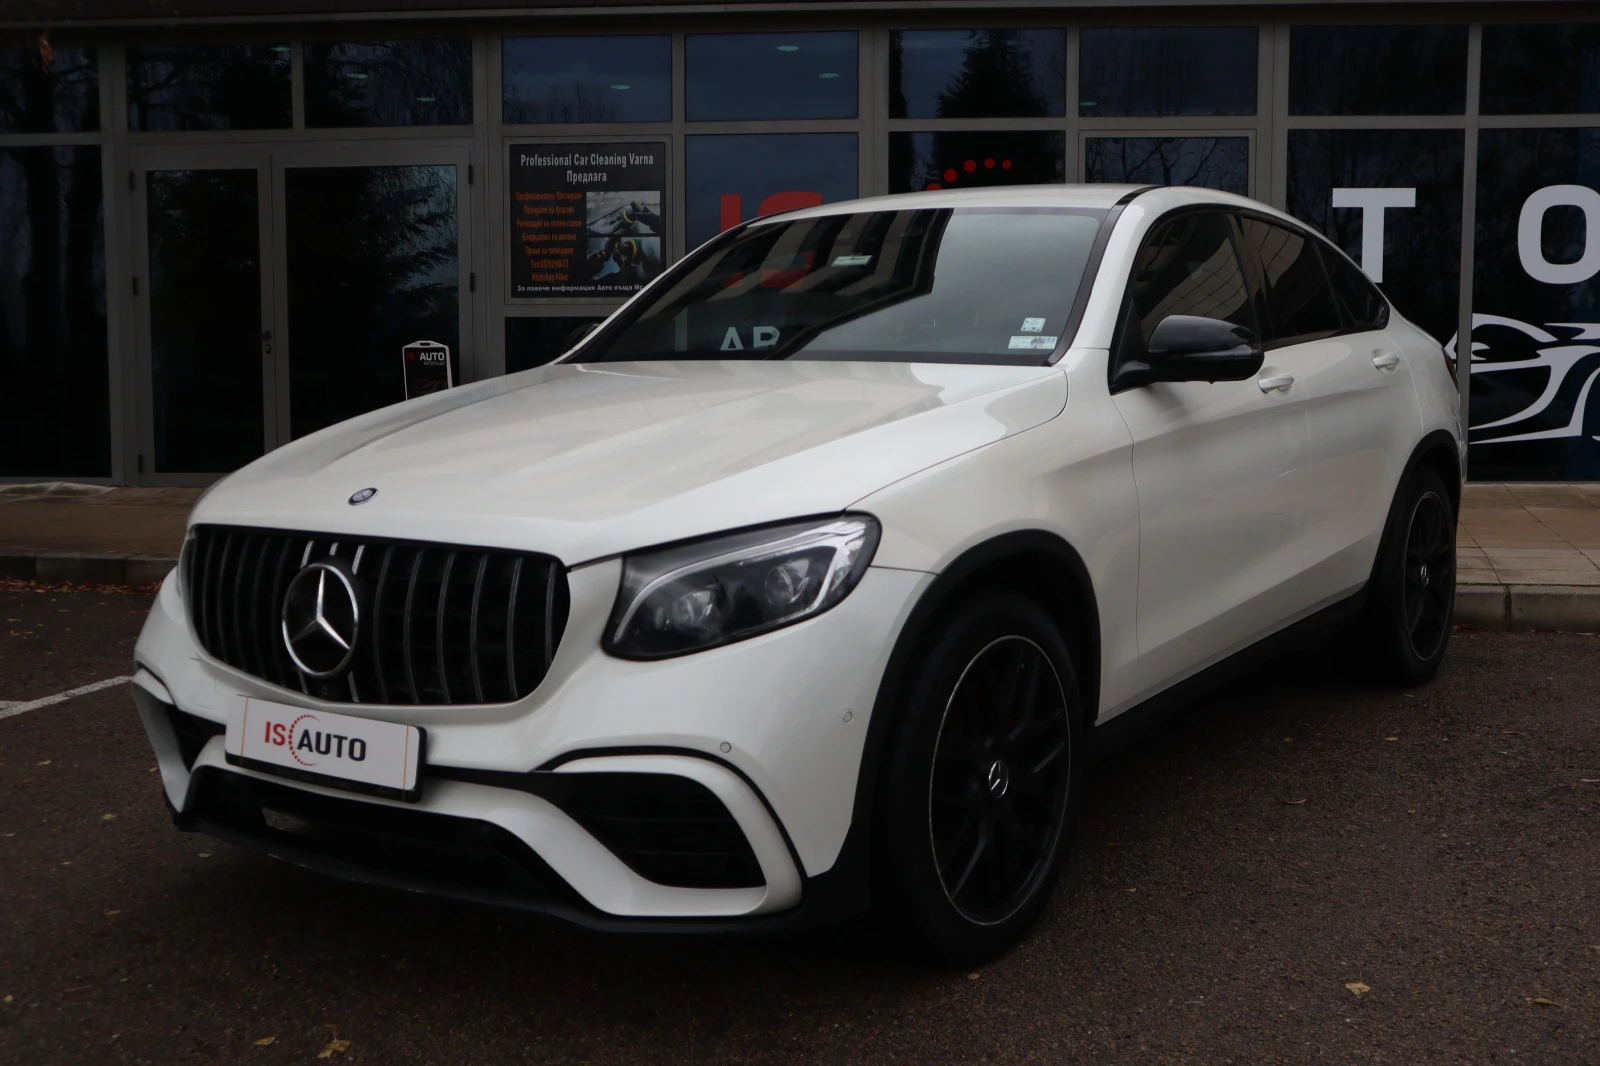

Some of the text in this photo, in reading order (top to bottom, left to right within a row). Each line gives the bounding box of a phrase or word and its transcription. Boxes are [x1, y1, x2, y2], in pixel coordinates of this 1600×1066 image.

[521, 153, 654, 168] Professional Car Cleaning Varna
[566, 170, 607, 184] Предлага
[551, 285, 596, 294] информация
[419, 352, 445, 361] AUTO
[264, 721, 366, 762] IS AUTO
